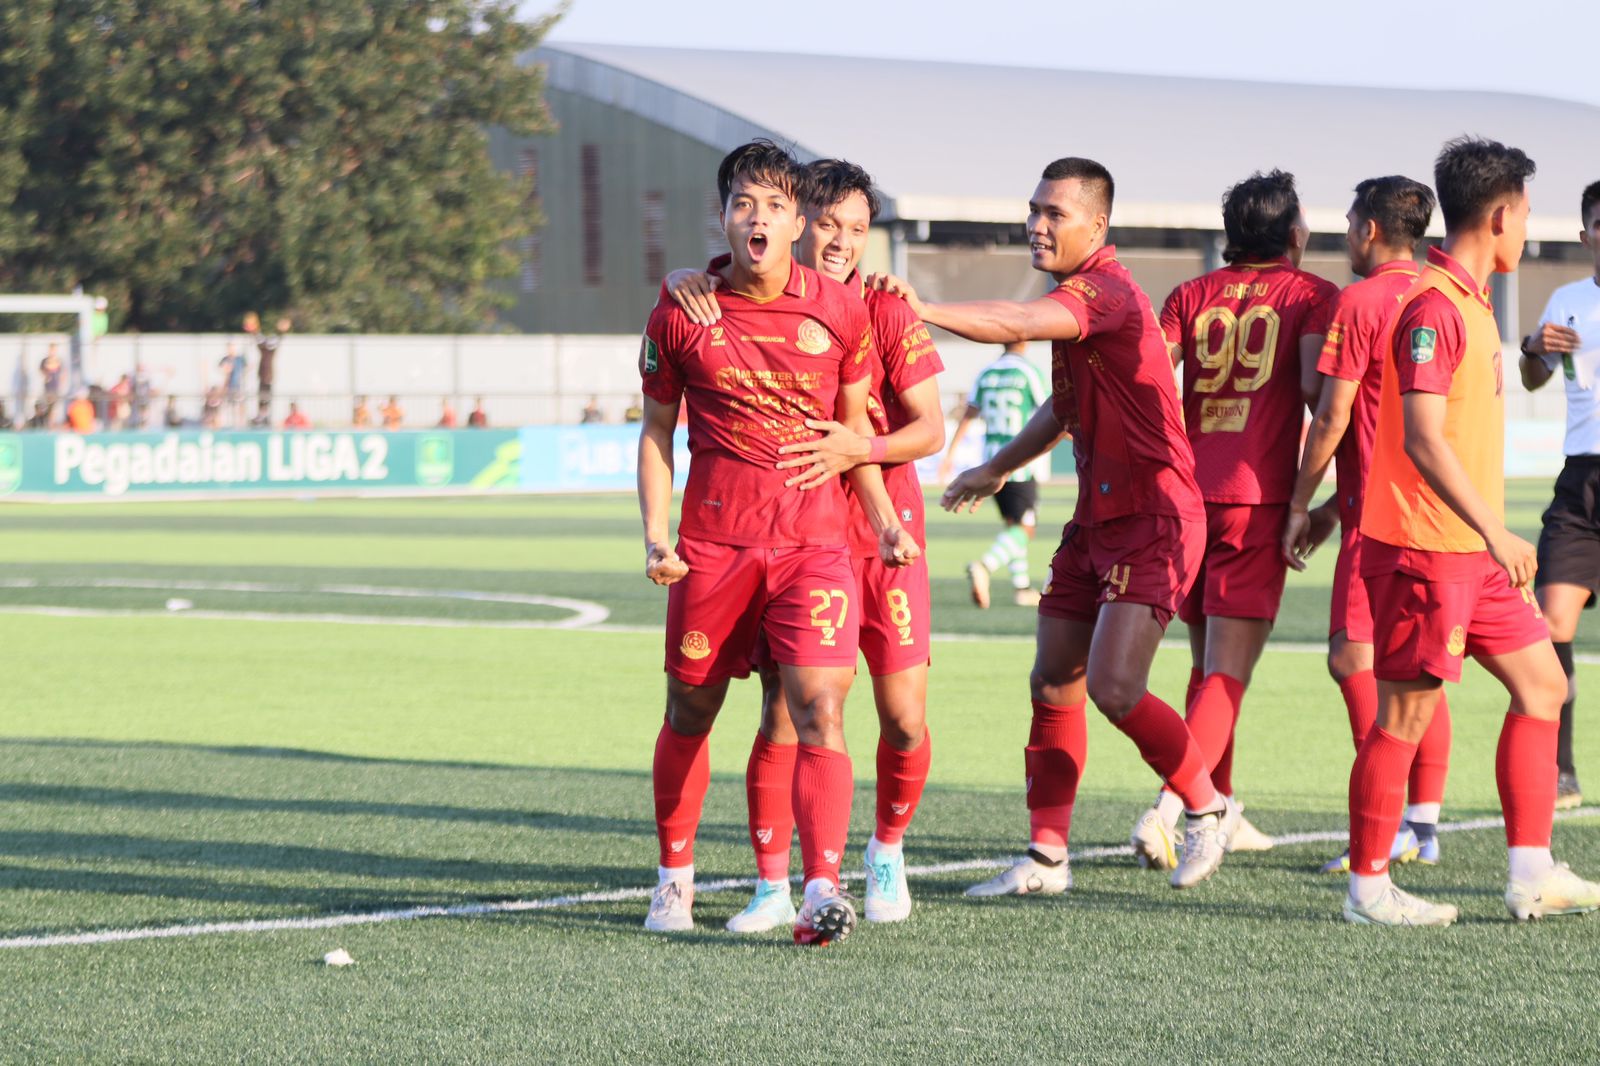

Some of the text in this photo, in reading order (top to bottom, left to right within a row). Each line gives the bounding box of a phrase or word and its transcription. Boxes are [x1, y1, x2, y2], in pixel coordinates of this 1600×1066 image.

[1193, 305, 1281, 393] 99
[740, 369, 794, 381] MONSTER
[54, 433, 262, 495] Pegadaian
[267, 433, 360, 482] LIGA
[360, 433, 389, 481] 2
[810, 589, 849, 629] 27
[886, 588, 912, 628] 8
